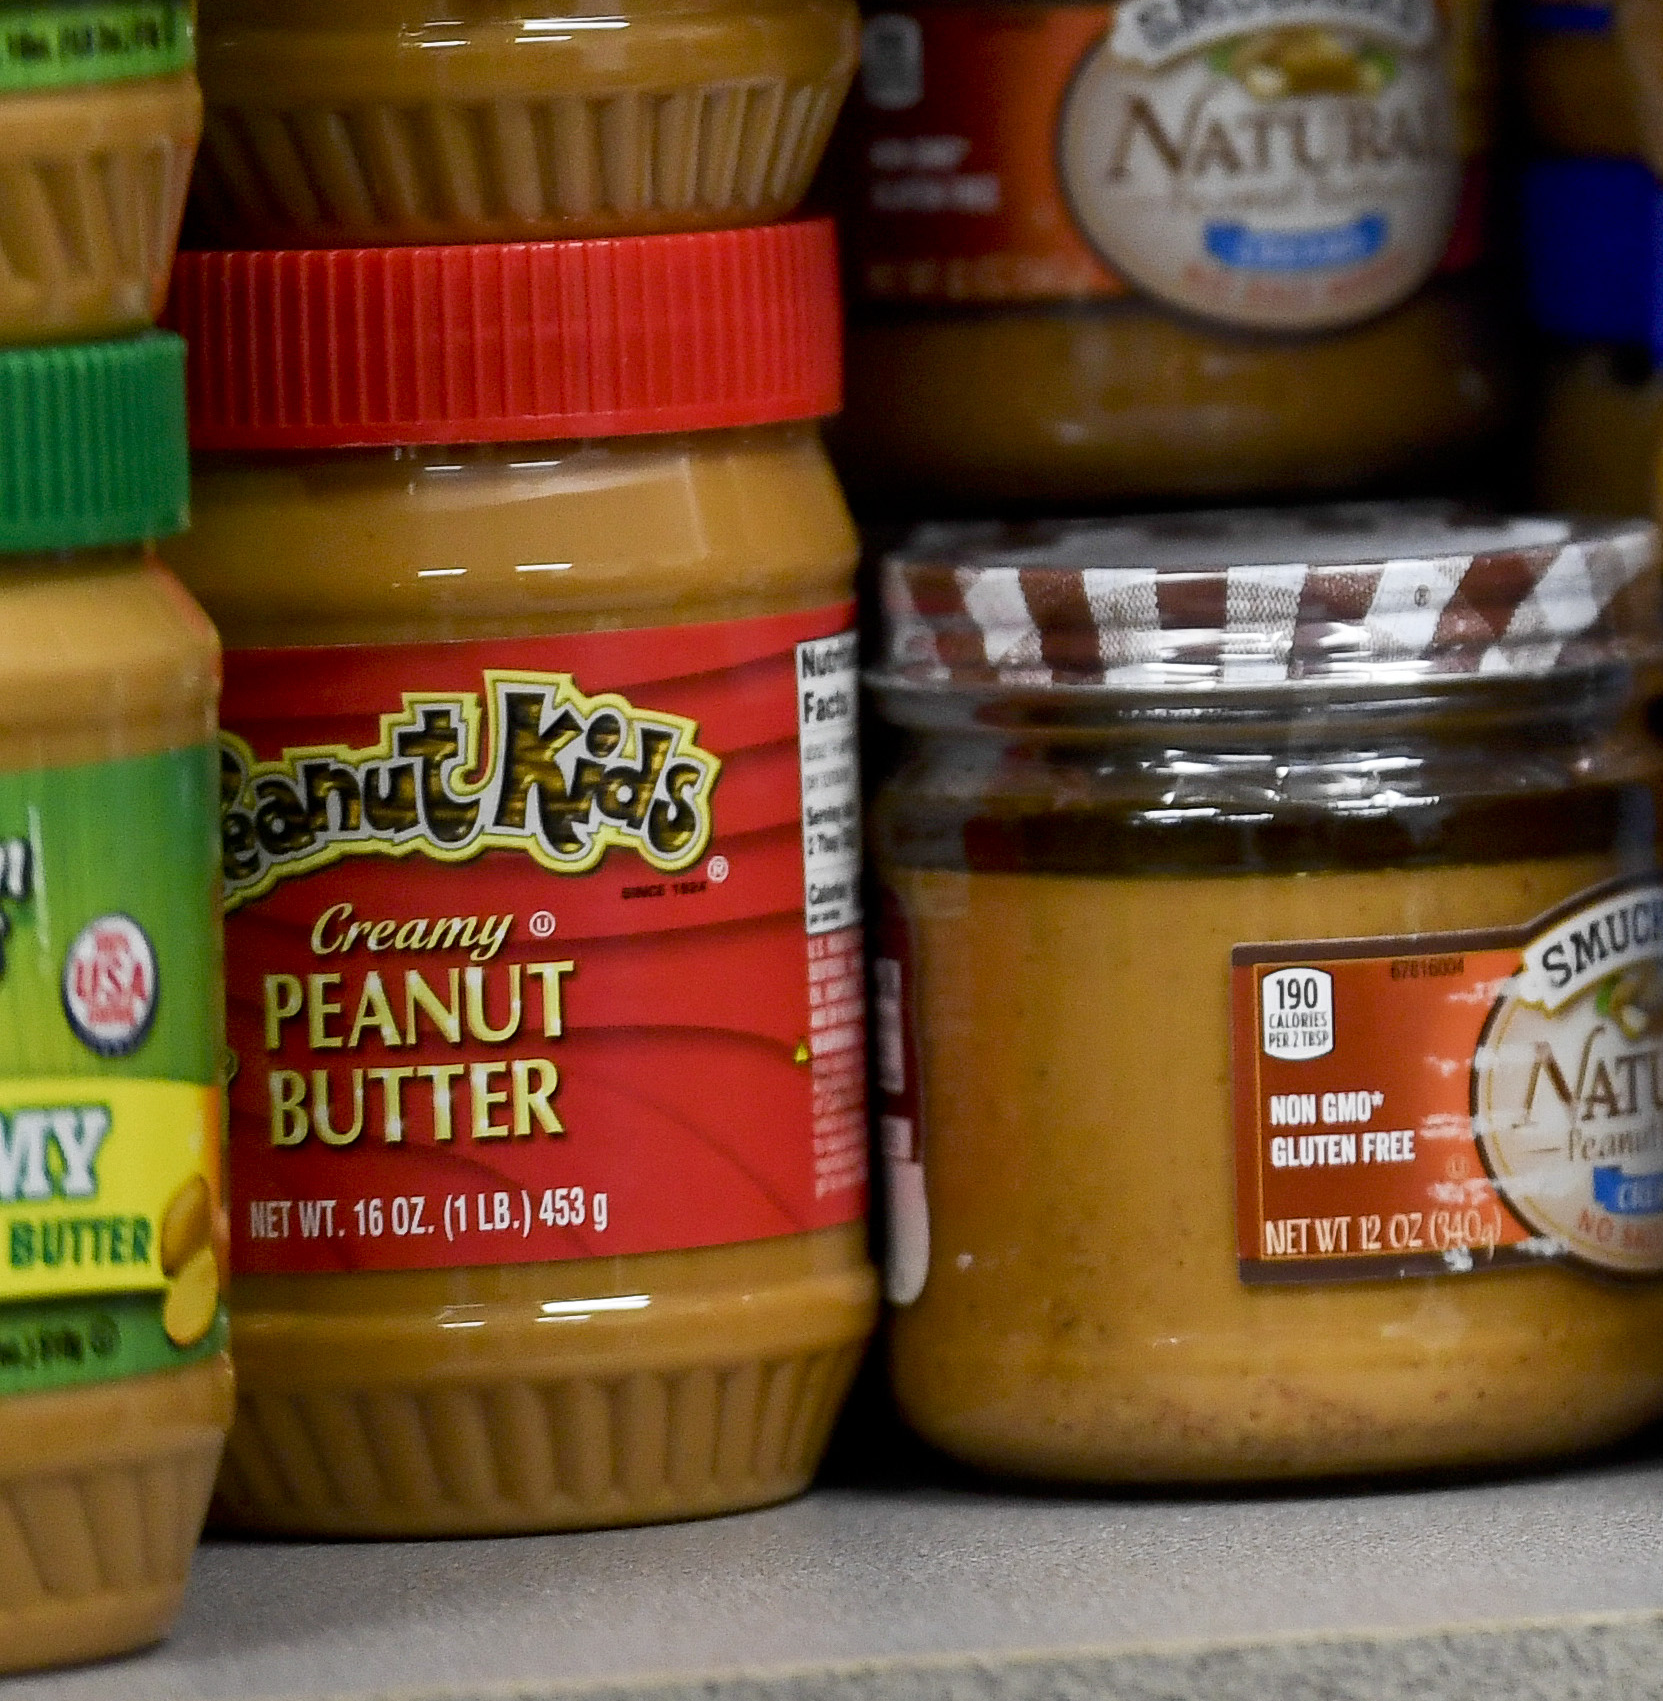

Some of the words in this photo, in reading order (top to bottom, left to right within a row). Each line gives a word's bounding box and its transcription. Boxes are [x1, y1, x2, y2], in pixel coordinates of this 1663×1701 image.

[490, 683, 710, 862] Kids
[311, 902, 513, 960] Creamy
[263, 959, 575, 1052] PEANUT
[1276, 977, 1318, 1010] 190
[1269, 1012, 1328, 1029] CALORIES
[269, 1058, 565, 1147] BUTTER
[1270, 1095, 1317, 1126] NON
[1271, 1134, 1356, 1169] GLUTEN
[1363, 1130, 1415, 1162] FREE
[250, 1199, 292, 1239] NET
[298, 1199, 345, 1238] WT.
[354, 1198, 383, 1236] 16
[392, 1196, 436, 1235] OZ.
[444, 1194, 469, 1241] (1
[477, 1191, 532, 1238] LB.)
[538, 1188, 586, 1229] 453
[593, 1193, 609, 1230] g
[1265, 1216, 1310, 1255] NET
[1316, 1215, 1352, 1252] WT
[1359, 1214, 1381, 1251] 12
[1389, 1212, 1424, 1248] OZ
[10, 1216, 151, 1268] BUTTER
